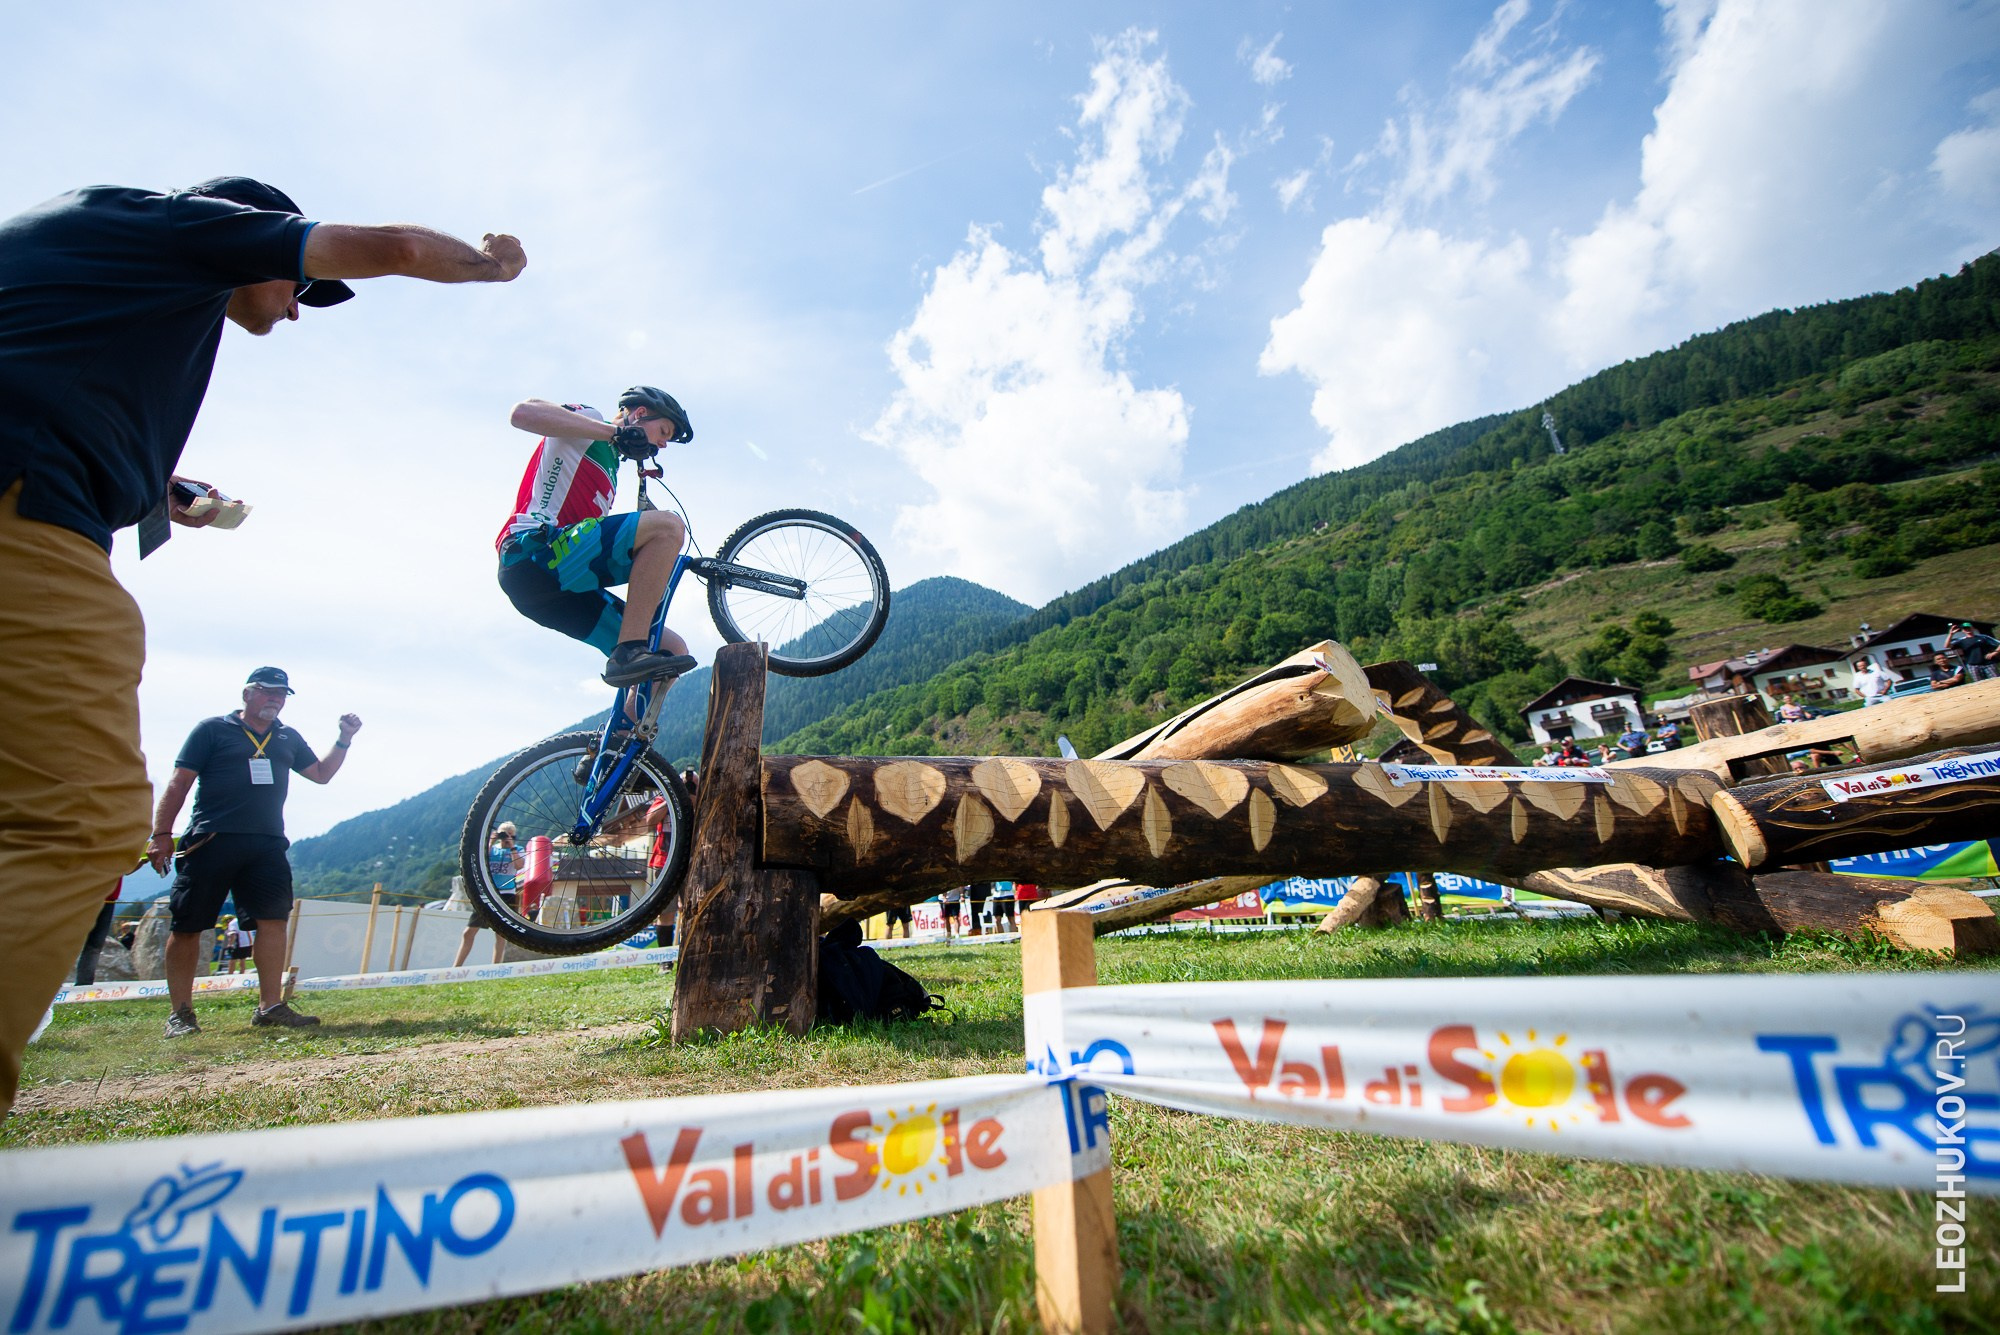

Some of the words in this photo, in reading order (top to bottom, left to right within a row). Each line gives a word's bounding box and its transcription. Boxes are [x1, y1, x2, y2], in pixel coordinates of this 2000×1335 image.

[1834, 782, 1867, 795] Val
[1868, 781, 1880, 790] di
[1876, 773, 1922, 789] Sole
[1927, 759, 2000, 781] TRENTIN
[1285, 876, 1358, 899] TRENTIN
[912, 910, 928, 930] Val
[930, 915, 939, 928] di
[1211, 1018, 1347, 1101] Val
[1364, 1064, 1424, 1107] di
[1427, 1025, 1694, 1129] Sole
[9, 1171, 516, 1335] TRENTINO
[621, 1127, 754, 1239] Val
[767, 1149, 823, 1212] di
[829, 1107, 1009, 1201] Sole
